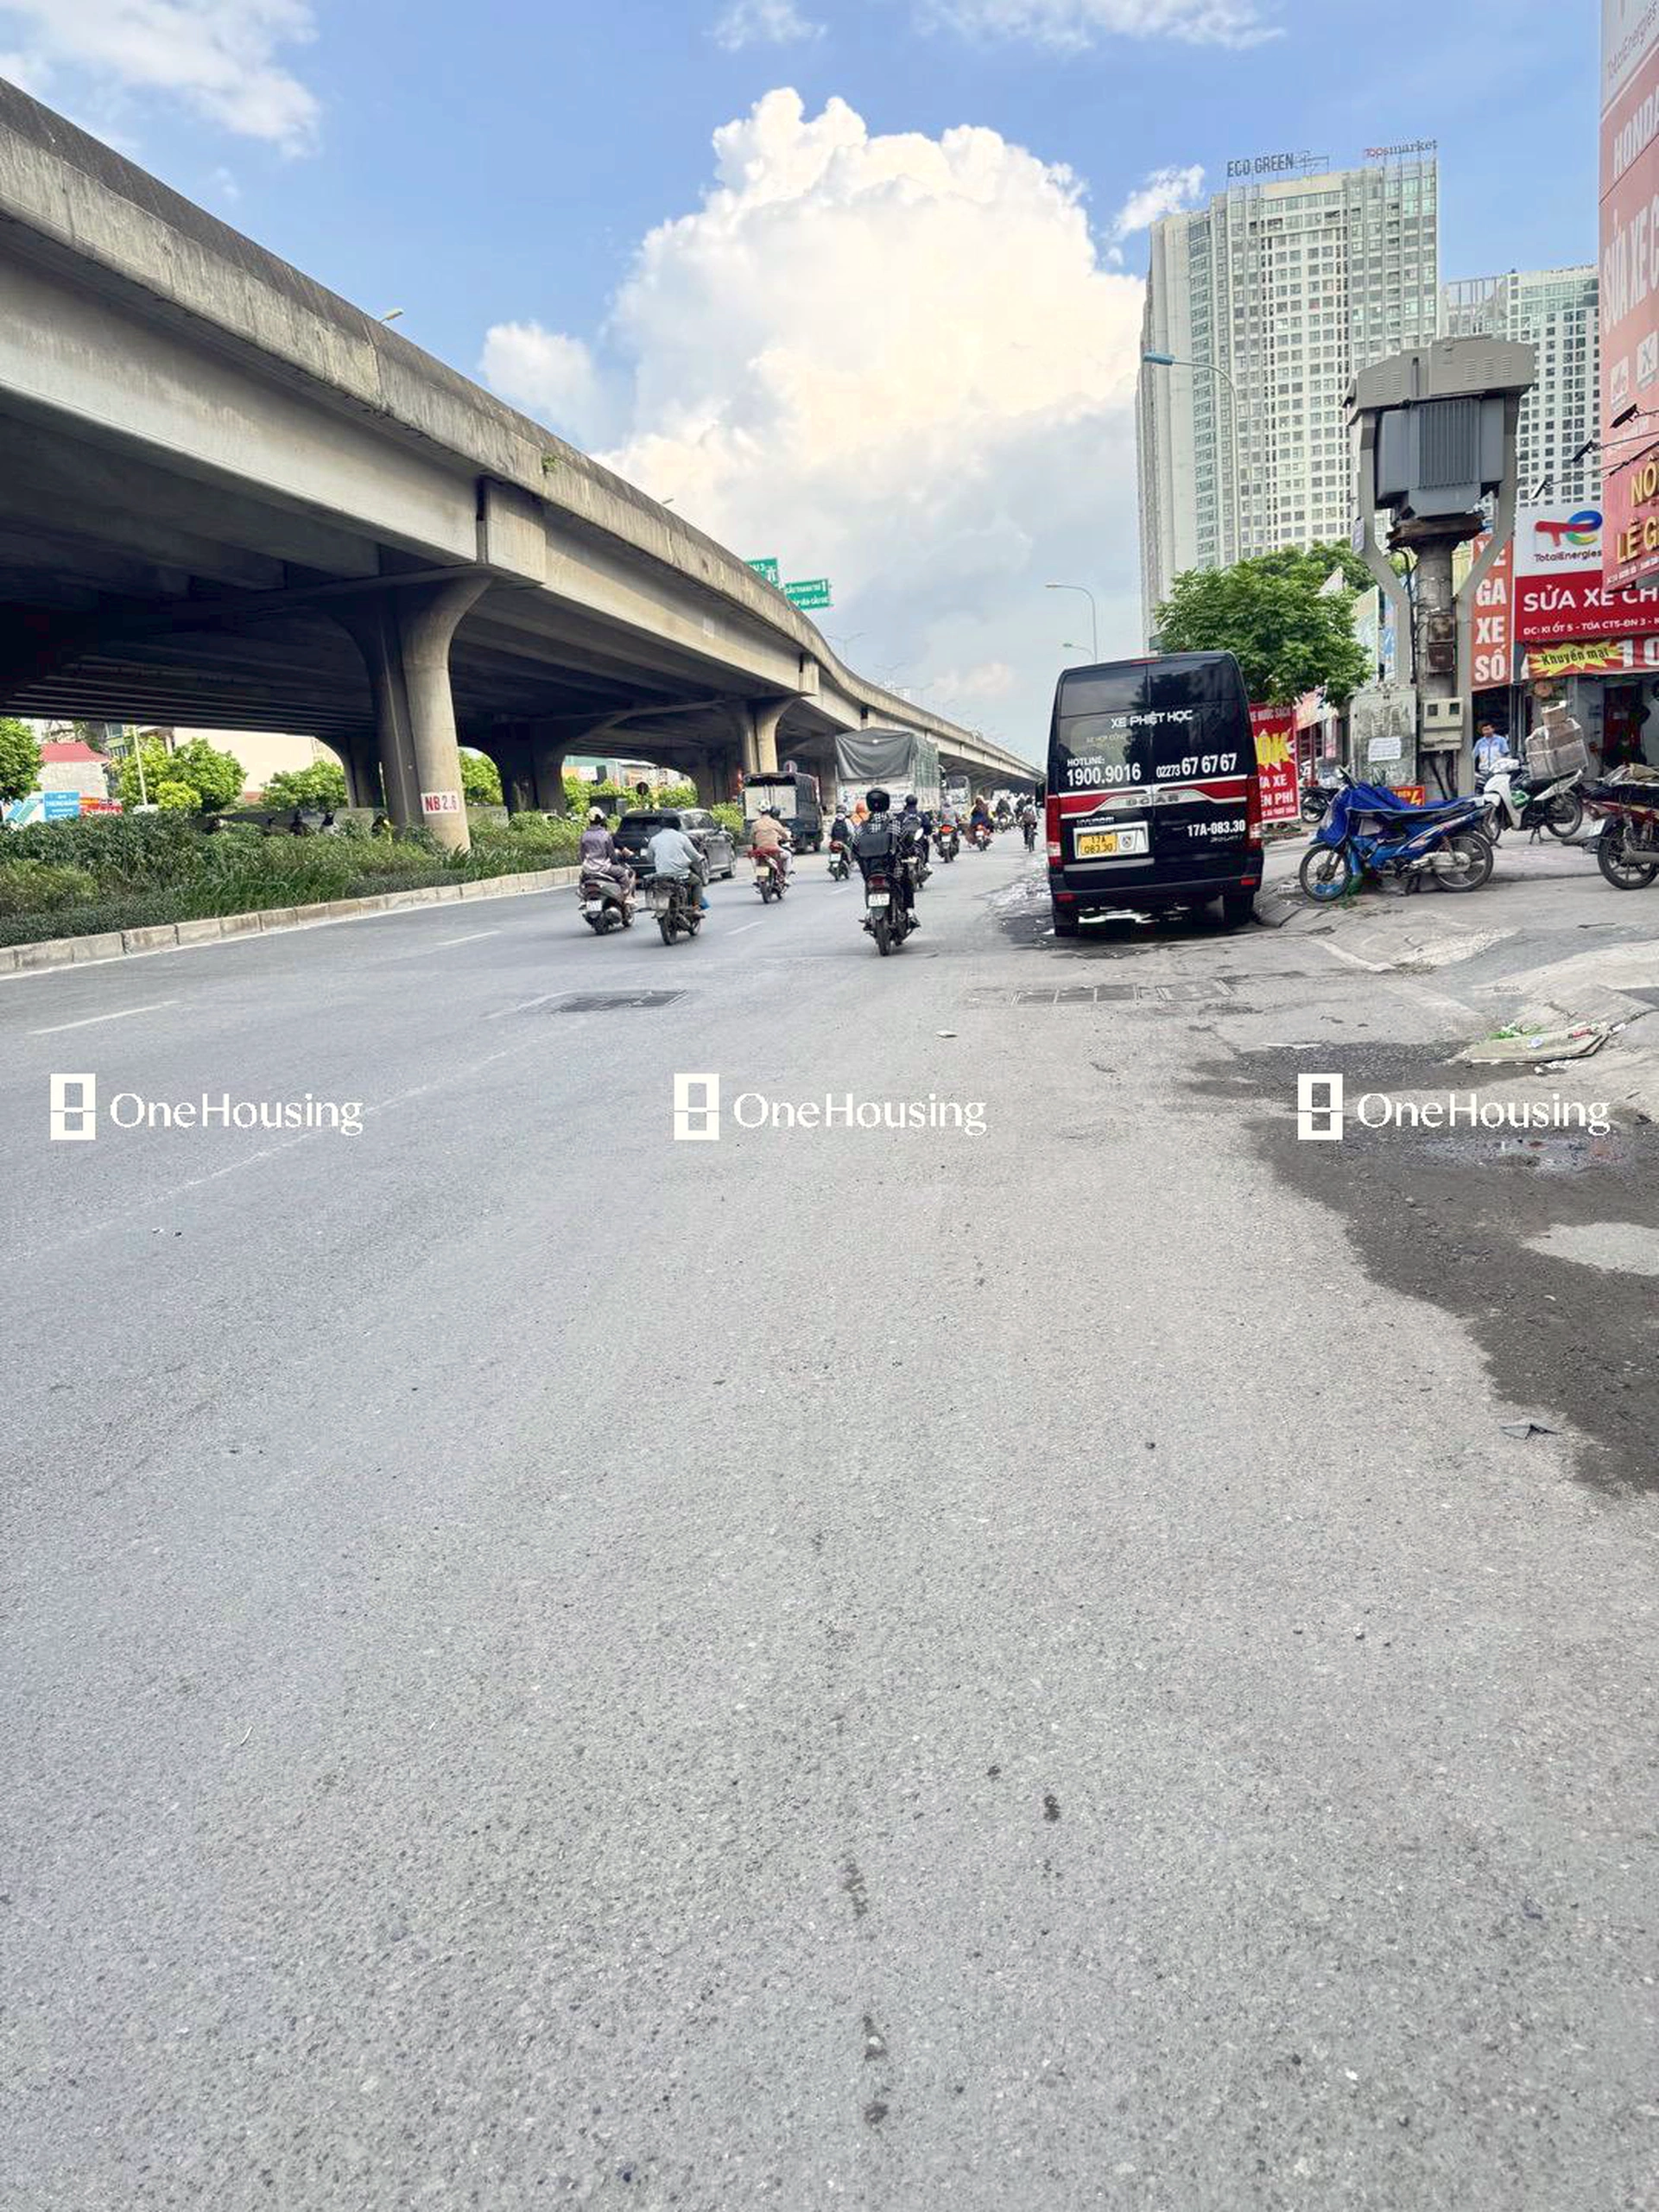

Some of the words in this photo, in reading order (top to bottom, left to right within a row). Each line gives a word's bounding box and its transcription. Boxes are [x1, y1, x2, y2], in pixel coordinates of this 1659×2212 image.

[1227, 159, 1251, 177] ECO
[1255, 153, 1295, 174] GREEN
[1534, 550, 1602, 563] TotalEnergies
[1476, 577, 1507, 606] GA
[1523, 584, 1577, 612] SỬA
[1583, 588, 1615, 607] XE
[1475, 616, 1505, 644] XE
[1474, 643, 1506, 682] SỐ
[1111, 716, 1127, 728] XE
[1130, 710, 1166, 726] PHIỆT
[1167, 710, 1193, 723] HỌC
[1067, 755, 1105, 767] HOTLINE:
[1067, 762, 1142, 787] 1900.9016
[1156, 764, 1181, 778] 02273
[1272, 774, 1288, 788] XE
[1274, 788, 1294, 807] PHÍ
[1187, 820, 1246, 837] 17A-083.30
